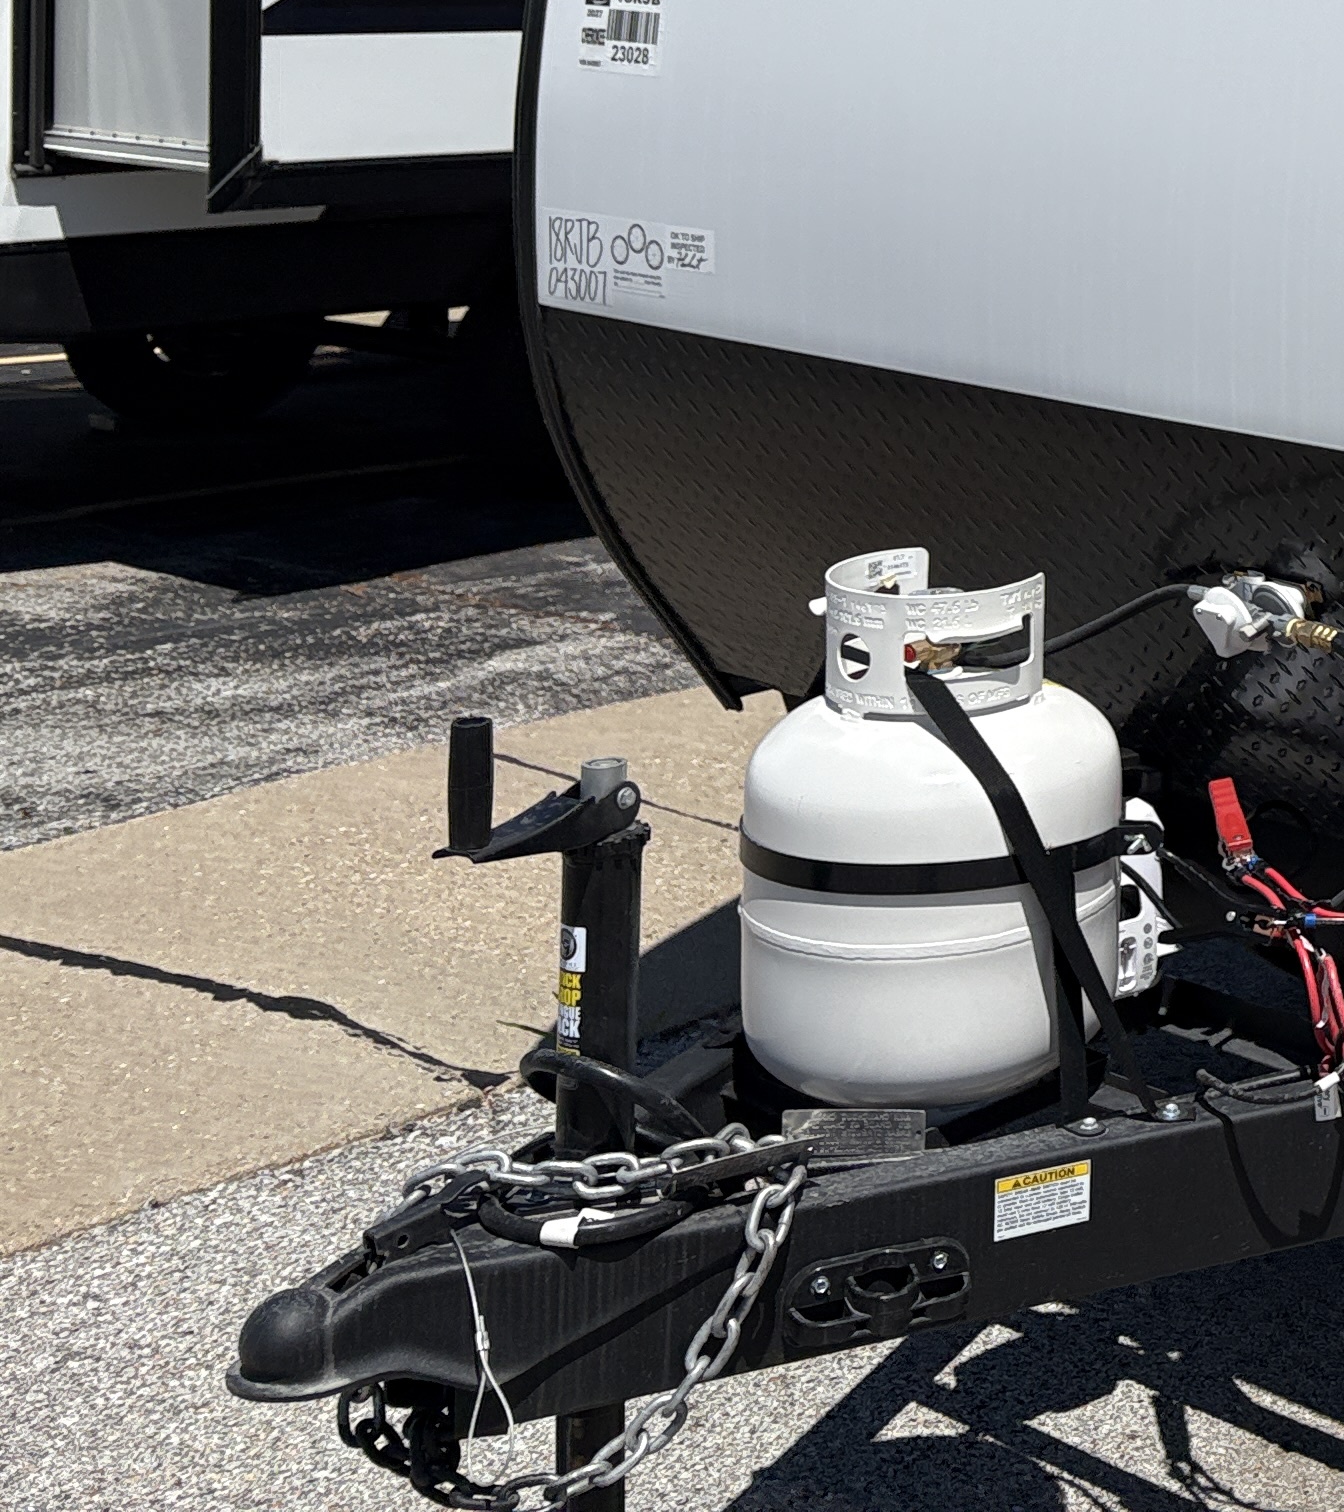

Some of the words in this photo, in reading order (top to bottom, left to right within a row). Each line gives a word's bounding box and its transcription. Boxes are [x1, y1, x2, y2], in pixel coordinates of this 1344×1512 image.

[610, 44, 650, 65] 23028
[548, 215, 604, 269] 18RJB
[547, 266, 607, 307] 043007
[1021, 1166, 1076, 1187] CAUTION
